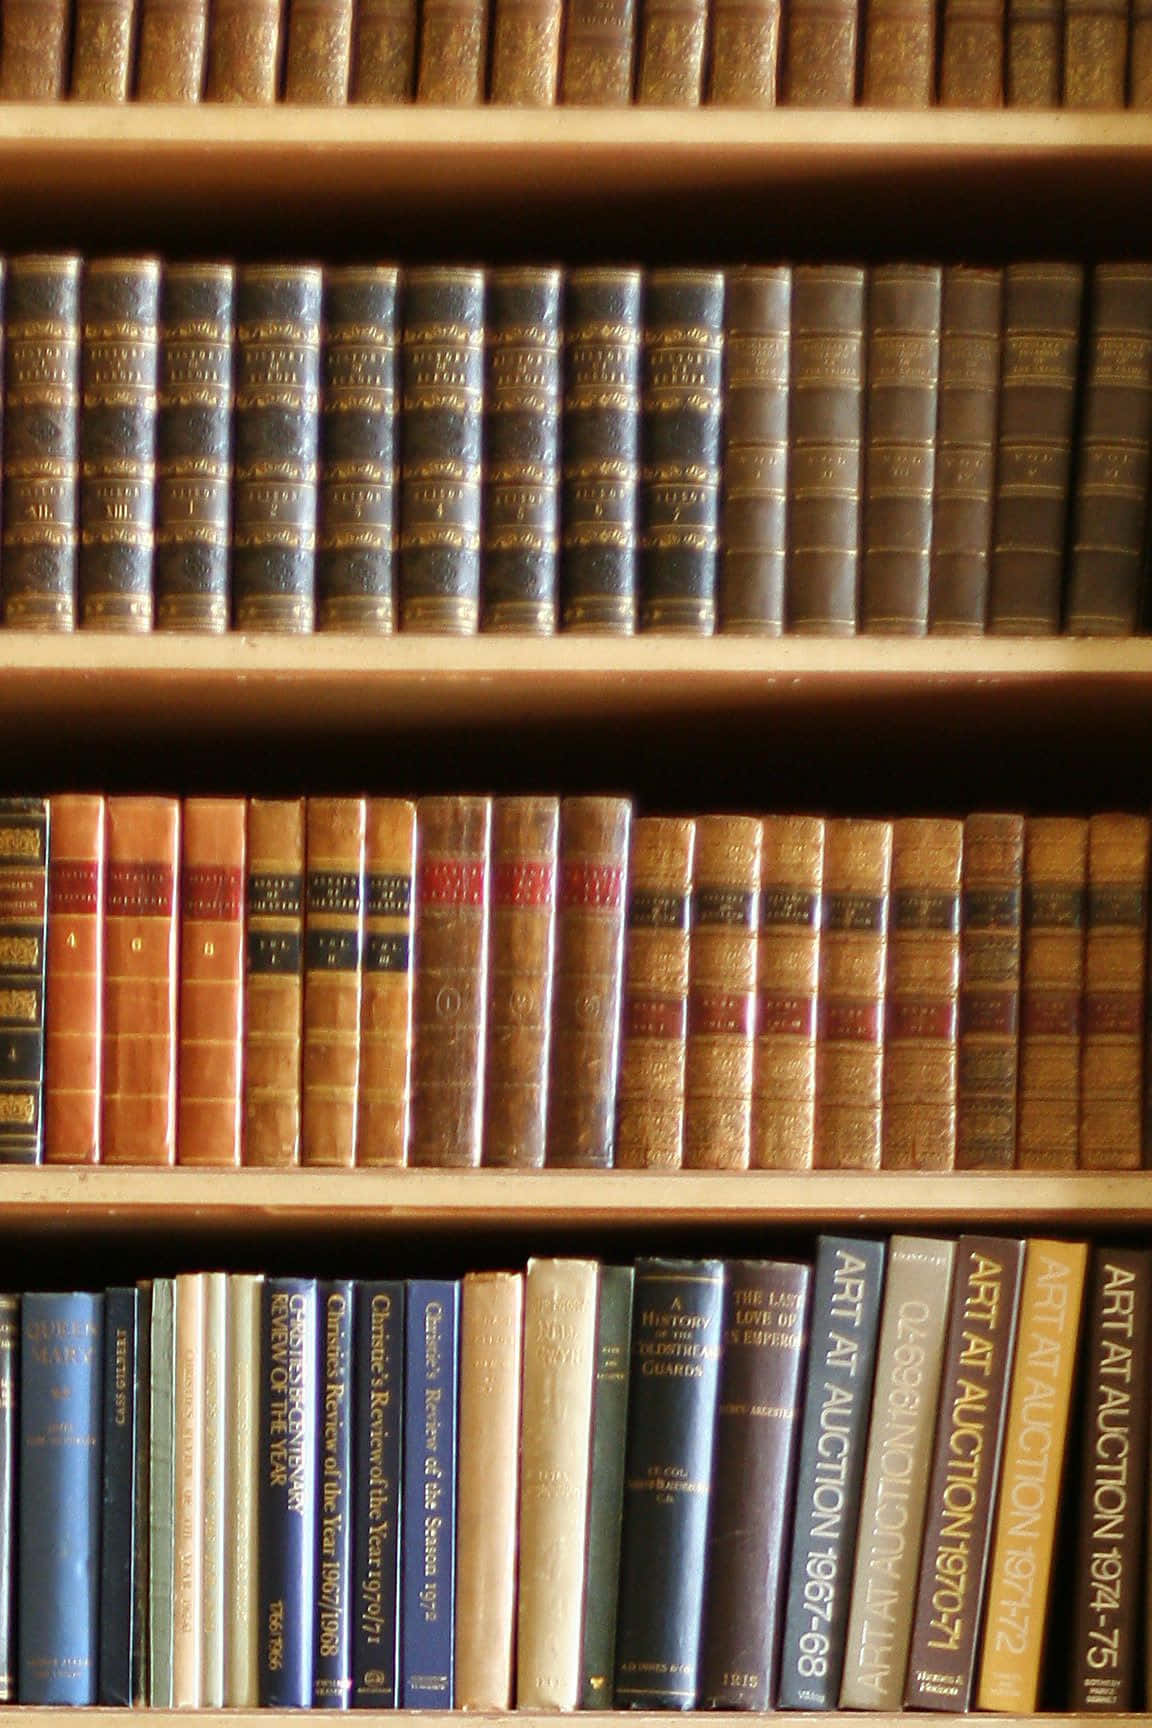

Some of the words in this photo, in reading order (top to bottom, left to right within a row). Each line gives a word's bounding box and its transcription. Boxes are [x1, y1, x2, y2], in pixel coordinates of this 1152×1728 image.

[735, 1290, 763, 1305] THE
[768, 1291, 802, 1309] LAST
[735, 1309, 772, 1326] LOVE
[777, 1313, 798, 1328] OF
[830, 1248, 868, 1328] ART
[964, 1251, 1003, 1329] ART
[1032, 1255, 1074, 1333] ART
[1100, 1263, 1137, 1338] ART
[26, 1320, 97, 1339] QUEEN
[33, 1346, 94, 1364] MARY
[270, 1293, 289, 1361] REVIEW
[370, 1293, 392, 1387] Christie's
[424, 1300, 444, 1381] Christie's
[825, 1330, 860, 1377] AT
[959, 1330, 995, 1377] AT
[1026, 1333, 1062, 1378] AT
[114, 1328, 128, 1395] GILBERT
[270, 1367, 289, 1393] OF
[889, 1301, 930, 1420] 1969-70
[1099, 1340, 1135, 1385] AT
[114, 1397, 128, 1427] CASS
[270, 1402, 288, 1435] THE
[324, 1383, 345, 1454] Review
[369, 1390, 391, 1462] Review
[424, 1388, 443, 1452] Review
[269, 1440, 288, 1487] YEAR
[323, 1456, 342, 1480] of
[369, 1465, 389, 1489] of
[423, 1456, 443, 1479] of
[809, 1381, 855, 1540] AUCTION
[939, 1378, 990, 1545] AUCTION
[1008, 1378, 1057, 1540] AUCTION
[1092, 1384, 1131, 1541] AUCTION
[323, 1481, 342, 1513] the
[368, 1489, 389, 1520] the
[423, 1480, 442, 1510] the
[869, 1423, 918, 1579] AUCTION
[322, 1514, 343, 1557] Year
[367, 1519, 390, 1565] Year
[424, 1515, 443, 1577] Season
[316, 1560, 342, 1658] 1967/1968
[361, 1570, 386, 1645] 1970/71
[419, 1583, 438, 1623] 1972
[797, 1546, 840, 1679] 1967-68
[863, 1578, 899, 1621] AT
[927, 1542, 970, 1651] 1970-71
[996, 1544, 1037, 1656] 1971-72
[1085, 1546, 1124, 1669] 1974-75
[857, 1620, 893, 1695] ART
